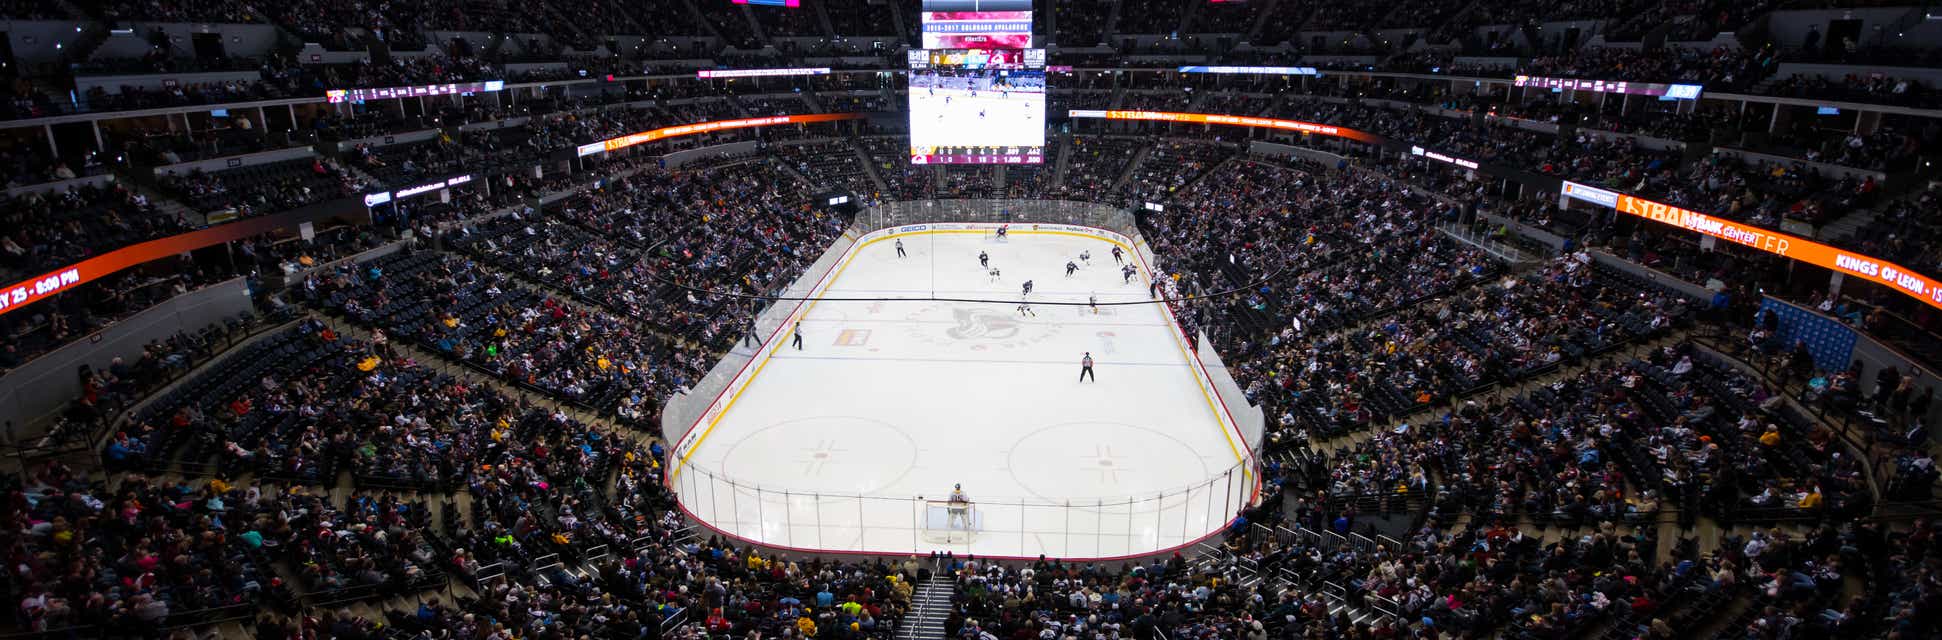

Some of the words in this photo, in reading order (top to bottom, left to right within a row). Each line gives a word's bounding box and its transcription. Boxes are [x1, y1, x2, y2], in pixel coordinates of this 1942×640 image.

[900, 225, 927, 233] GEICO
[12, 286, 28, 304] 25
[35, 275, 60, 295] 8:00
[60, 267, 80, 286] PM
[1836, 254, 1879, 277] KINGS
[1881, 266, 1898, 282] OF
[1897, 272, 1925, 295] LEON
